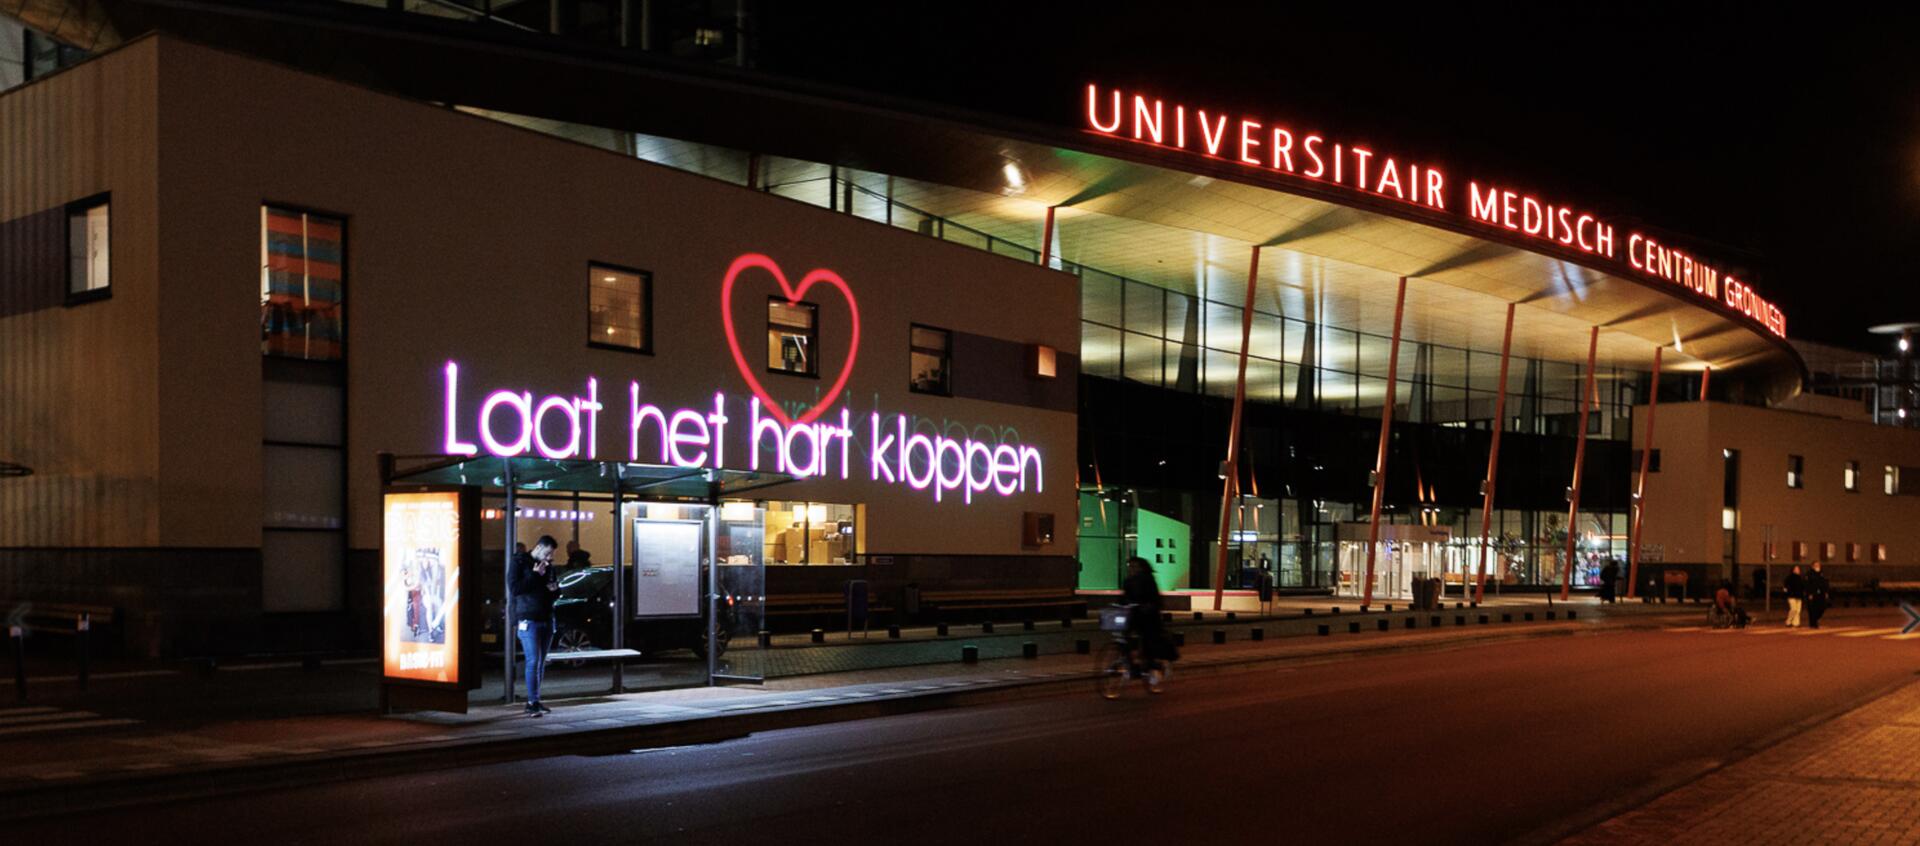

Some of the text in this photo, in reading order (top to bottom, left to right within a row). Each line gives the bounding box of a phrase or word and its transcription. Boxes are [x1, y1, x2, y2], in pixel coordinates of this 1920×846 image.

[1086, 83, 1787, 339] UNIVERSITAIR MEDISCH CENTRUM GRONINGEN
[444, 360, 1044, 505] Laat het hart kloppen
